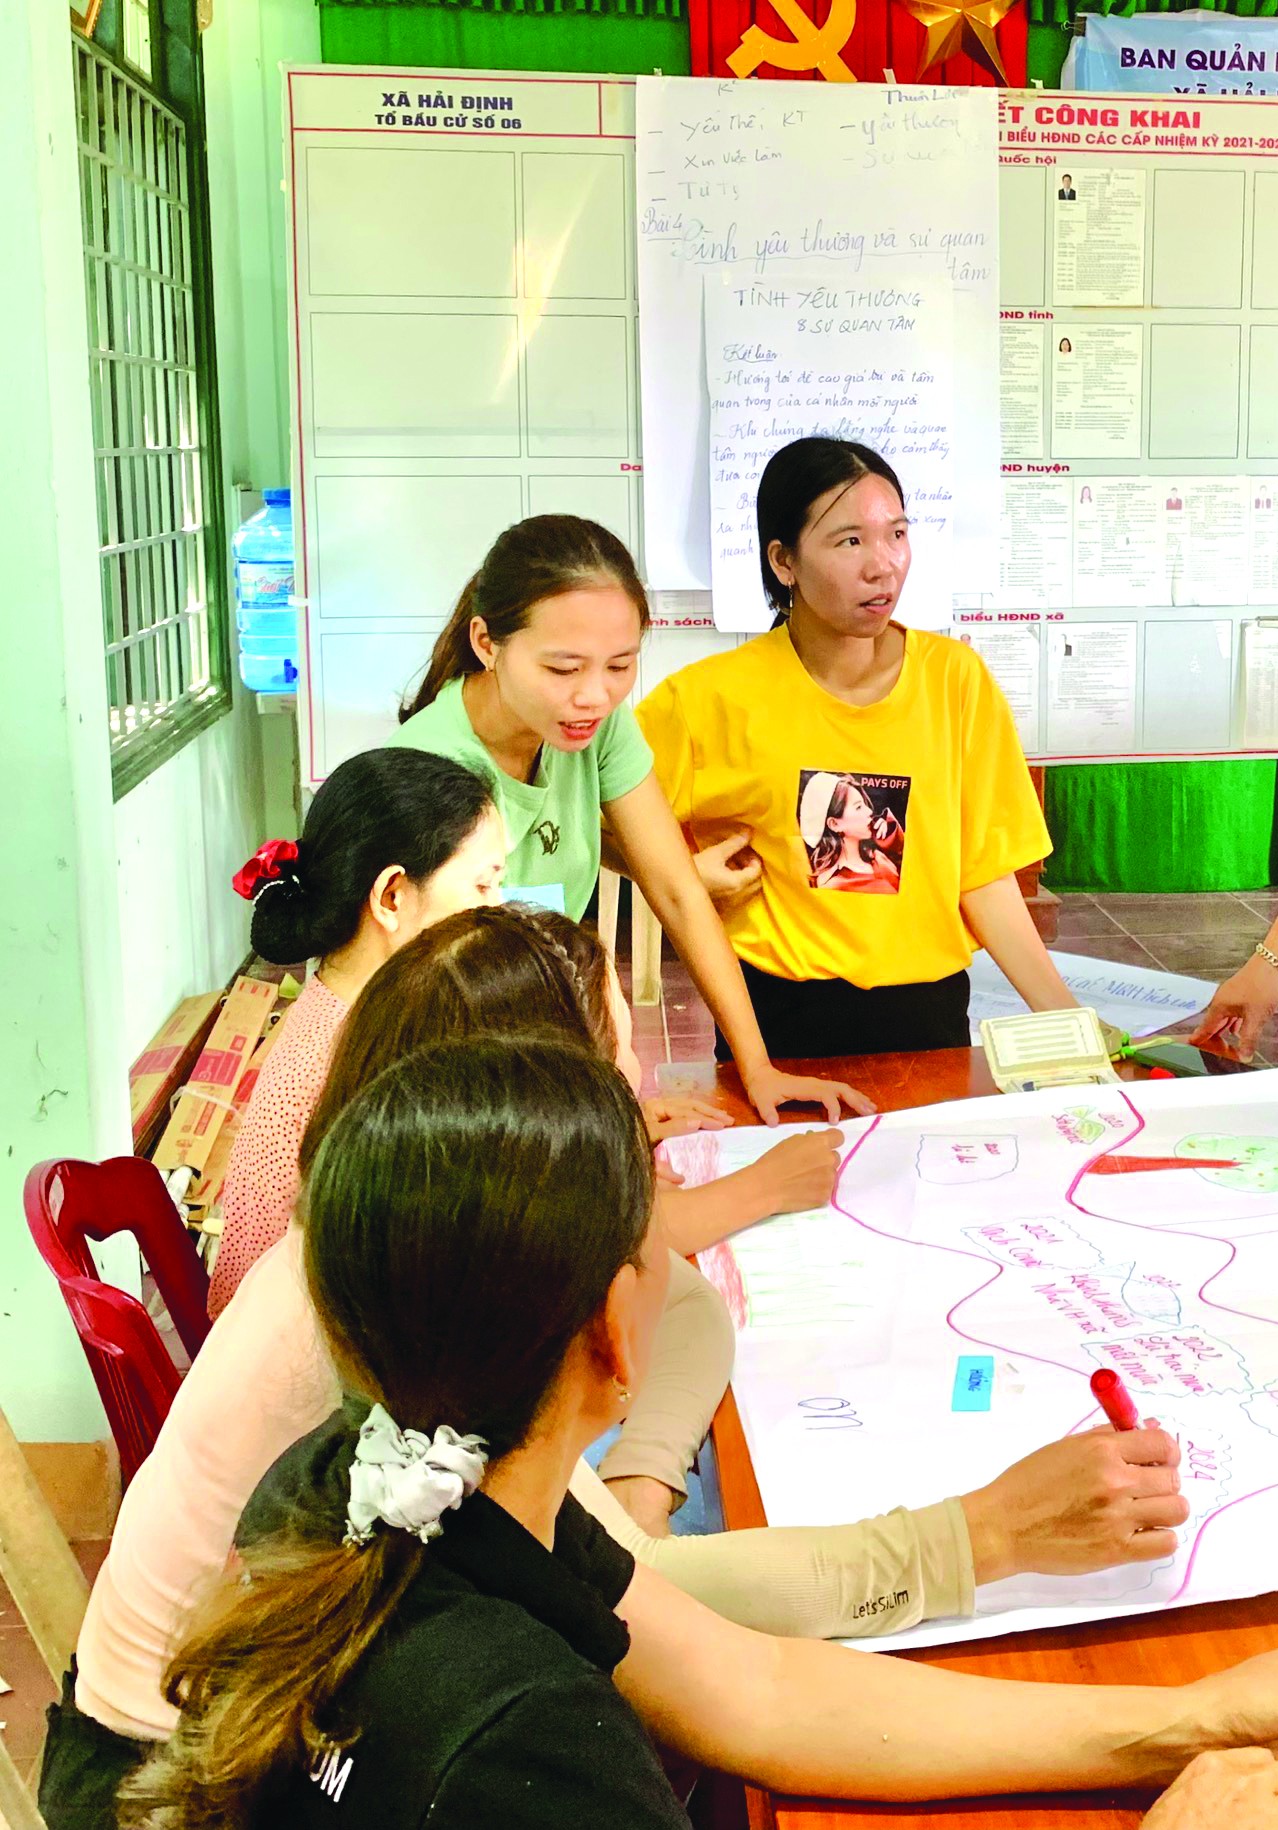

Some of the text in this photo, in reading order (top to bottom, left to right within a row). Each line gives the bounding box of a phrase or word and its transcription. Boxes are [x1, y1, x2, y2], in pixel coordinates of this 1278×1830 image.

[1120, 47, 1176, 69] BAN
[1185, 43, 1265, 72] QUẢN
[381, 91, 513, 113] XÃ HẢI ĐỊNH
[375, 110, 396, 125] TỔ
[443, 113, 468, 128] CỬ
[472, 114, 495, 128] SỐ
[501, 118, 522, 129] 06
[1035, 104, 1120, 127] CÔNG
[1130, 110, 1200, 128] KHAI
[1007, 126, 1036, 142] BIỂU
[1041, 132, 1080, 143] HĐND
[1085, 131, 1117, 145] CÁC
[1121, 131, 1150, 146] CẤP
[1155, 133, 1197, 149] NHIỆM
[1202, 133, 1219, 147] KỲ
[1035, 155, 1056, 165] hội
[1028, 309, 1053, 319] tỉnh
[1000, 464, 1022, 472] ND
[1027, 463, 1070, 474] huyện
[674, 618, 712, 626] sách
[960, 610, 993, 622] biểu
[997, 613, 1040, 622] HĐND
[1045, 612, 1064, 621] xã
[861, 777, 908, 789] PAYS OFF
